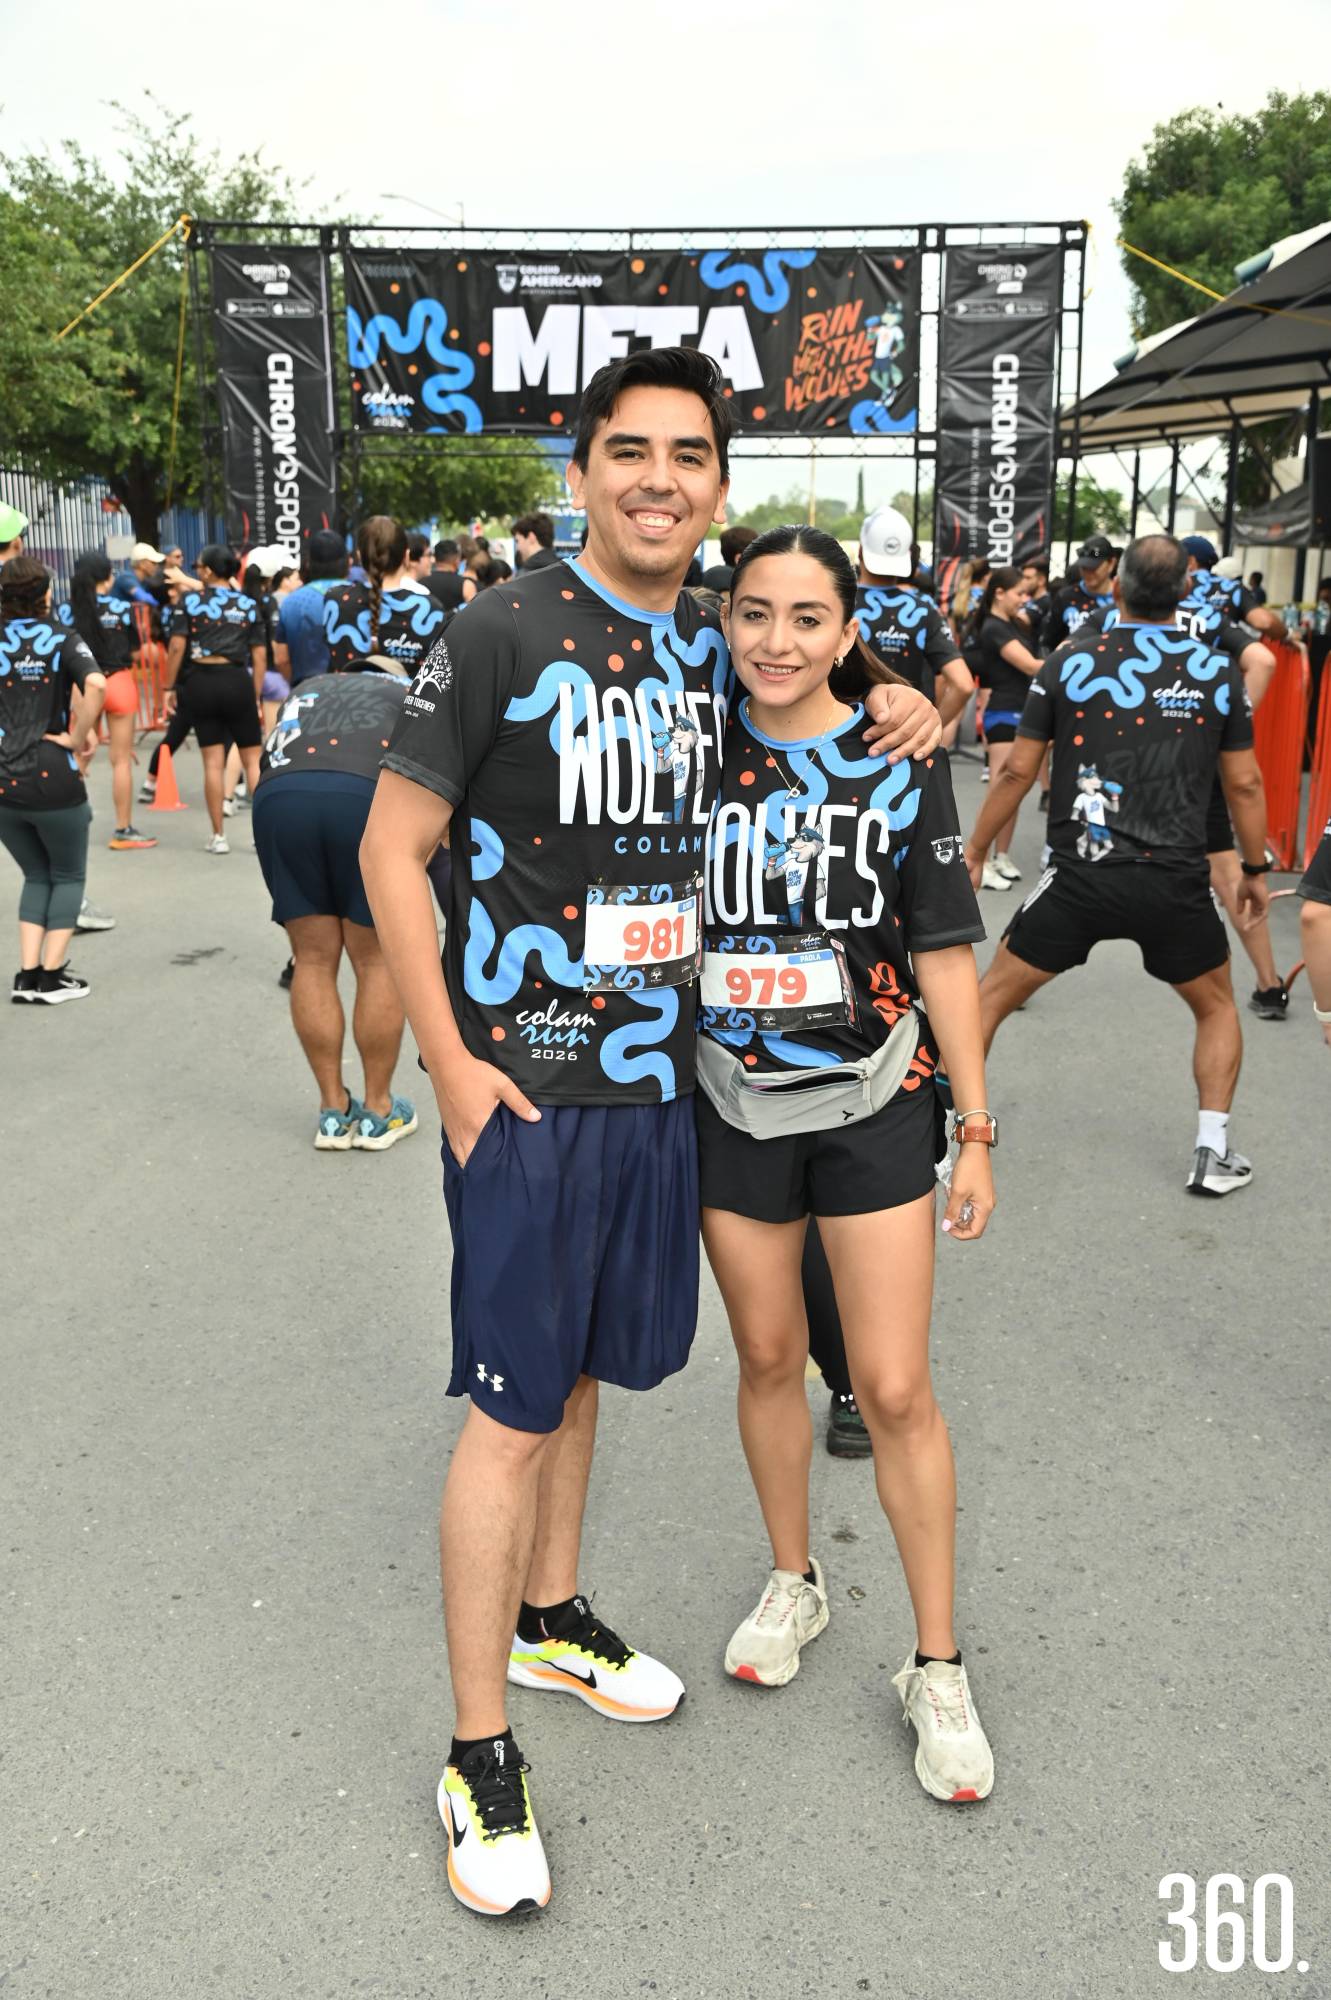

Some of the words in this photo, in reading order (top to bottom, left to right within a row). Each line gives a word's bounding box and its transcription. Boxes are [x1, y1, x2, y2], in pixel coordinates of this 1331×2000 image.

[520, 275, 603, 288] AMERICANO
[798, 299, 864, 353] RUN
[785, 358, 874, 412] WOLVES
[1152, 679, 1206, 700] colam
[1161, 709, 1193, 719] 2026
[704, 799, 890, 930] OLES
[622, 915, 685, 962] 981
[799, 952, 821, 963] PAOLA
[725, 967, 808, 1006] 979
[515, 998, 597, 1029] colam
[519, 1024, 591, 1048] run
[530, 1048, 578, 1061] 2026
